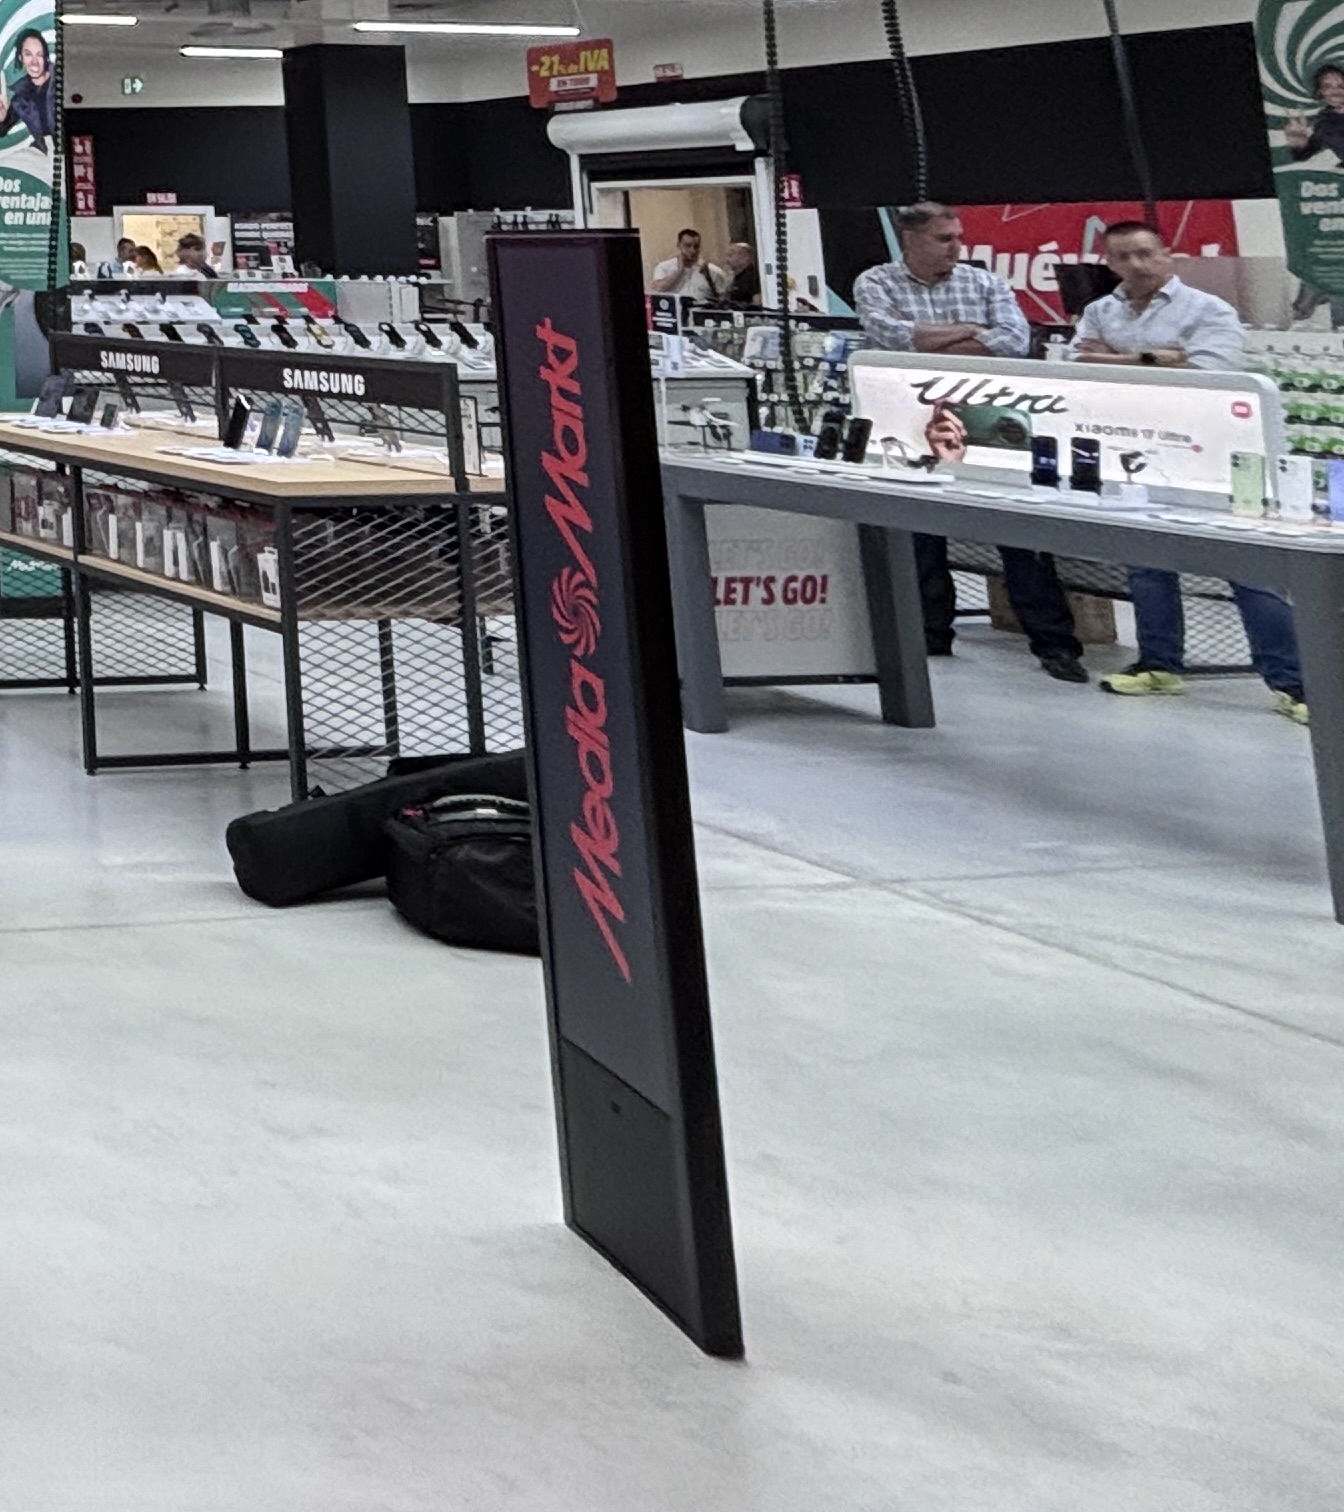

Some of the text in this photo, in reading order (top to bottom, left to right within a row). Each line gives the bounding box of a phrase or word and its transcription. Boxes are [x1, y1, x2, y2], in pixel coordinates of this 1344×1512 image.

[4, 210, 24, 226] en
[100, 350, 161, 375] SAMSUNG
[282, 367, 366, 397] SAMSUNG
[910, 375, 1070, 415] Ultra
[711, 574, 829, 606] LET'S GO!
[536, 316, 631, 983] Media Markt
